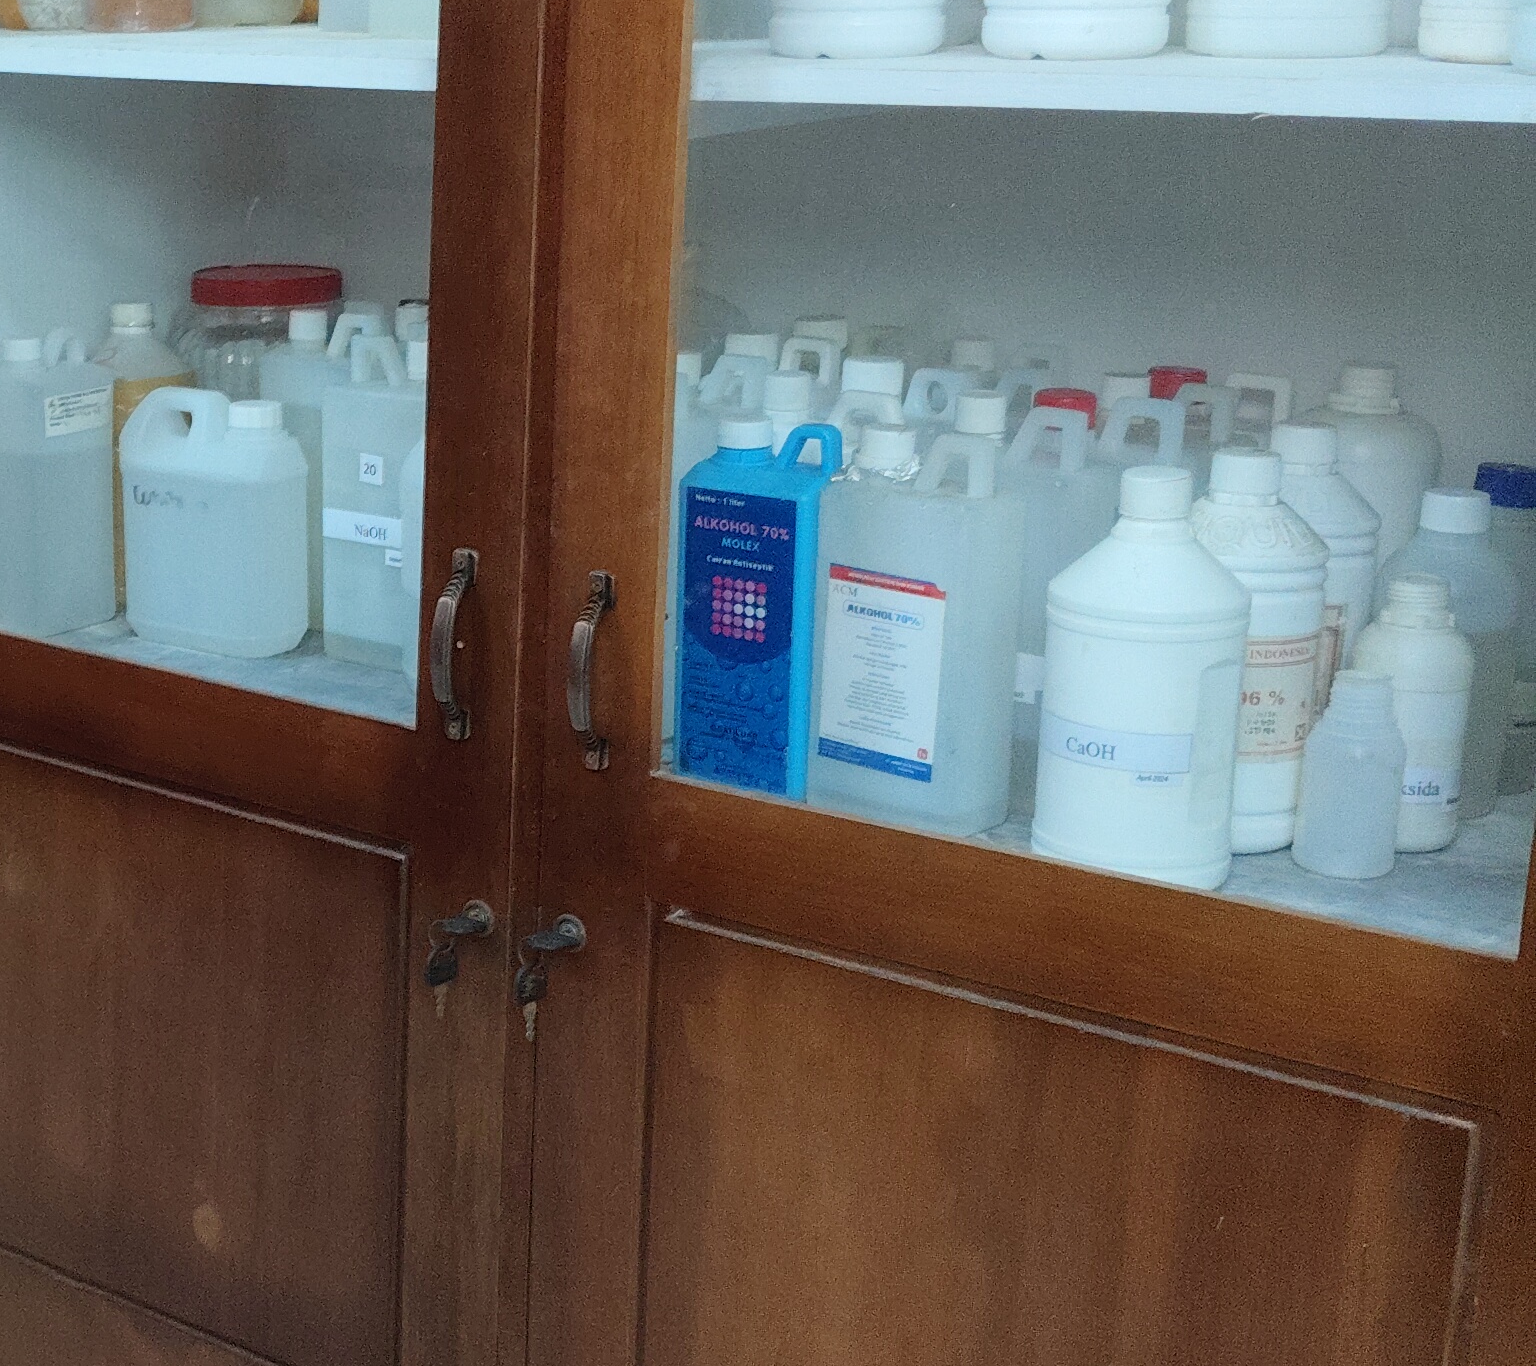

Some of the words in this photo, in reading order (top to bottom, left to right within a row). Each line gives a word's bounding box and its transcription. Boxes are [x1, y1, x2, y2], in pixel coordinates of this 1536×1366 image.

[354, 524, 388, 541] NaOH
[694, 515, 757, 536] ALKOHOL
[762, 525, 790, 541] 70%
[721, 537, 760, 552] MOLEX
[846, 604, 893, 622] ALKOHOL
[1066, 736, 1116, 761] CaOH
